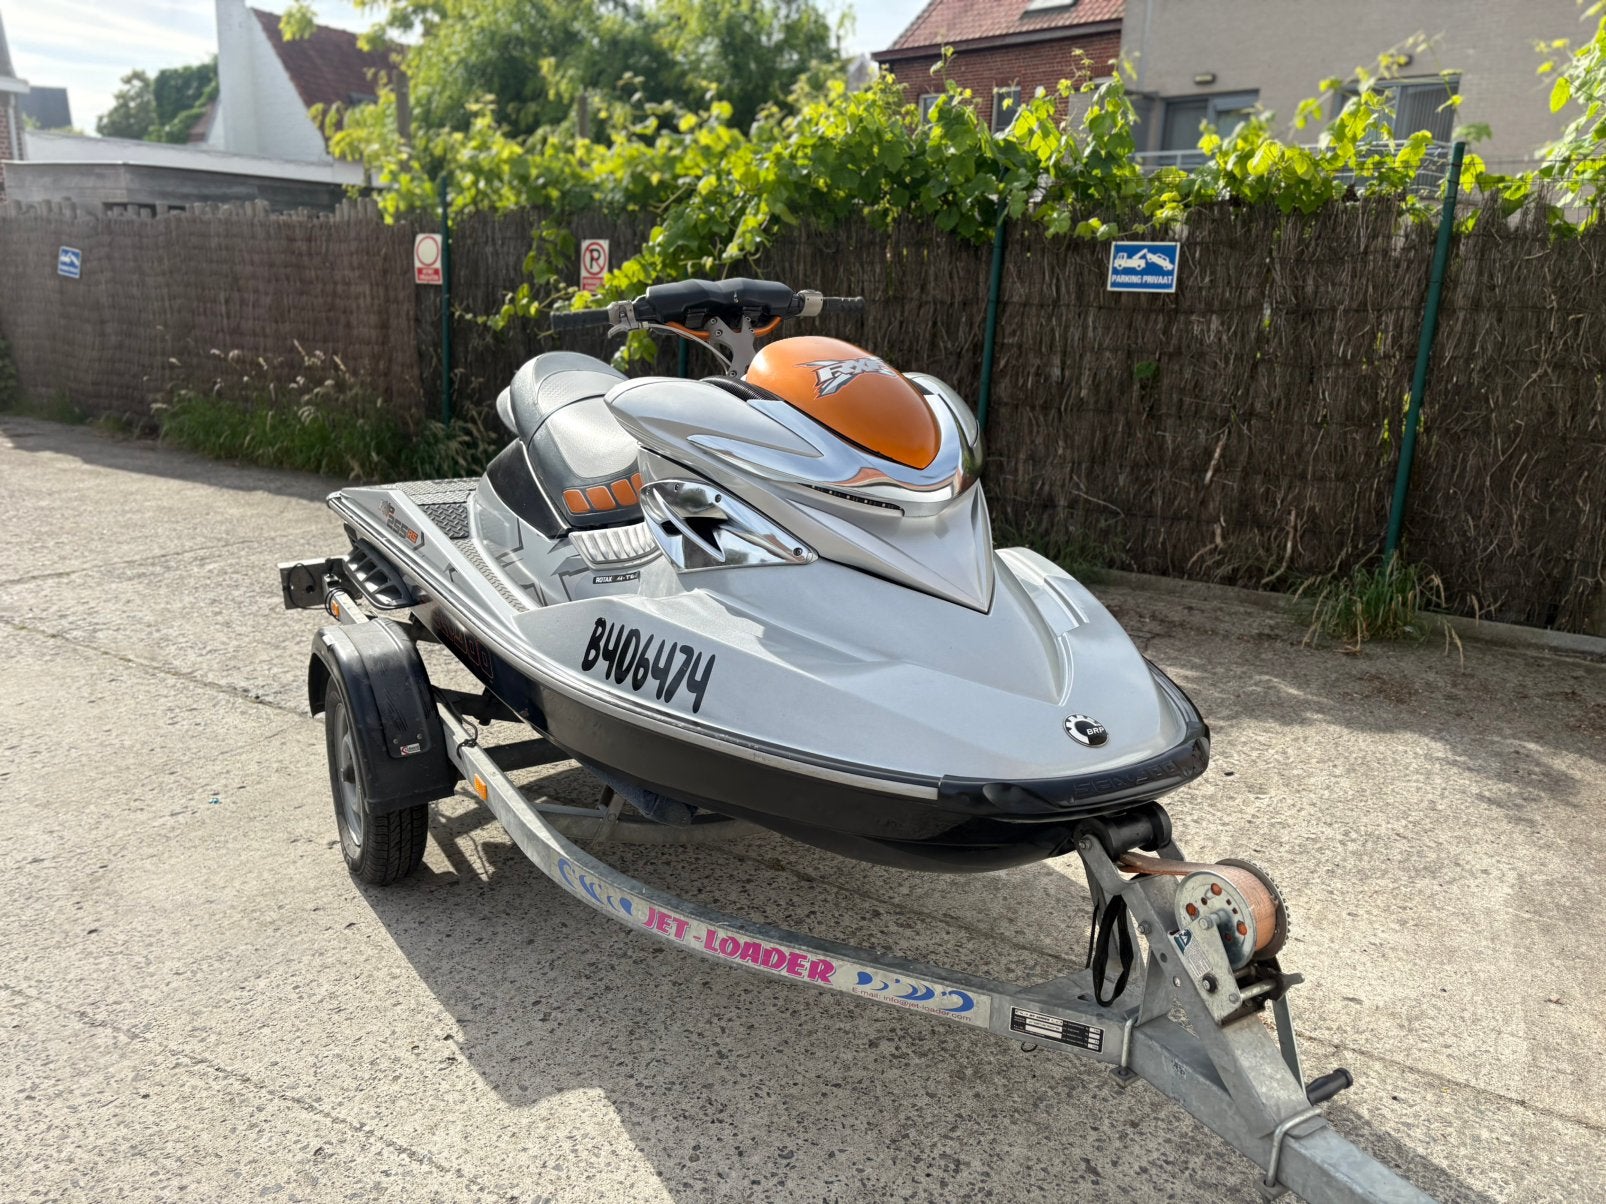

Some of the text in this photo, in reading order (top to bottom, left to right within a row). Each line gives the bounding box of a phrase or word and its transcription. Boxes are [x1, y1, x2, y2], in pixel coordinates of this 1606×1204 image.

[1111, 274, 1173, 285] PARKING PRIVAAT
[581, 616, 716, 714] B406474
[1086, 726, 1105, 736] BRP
